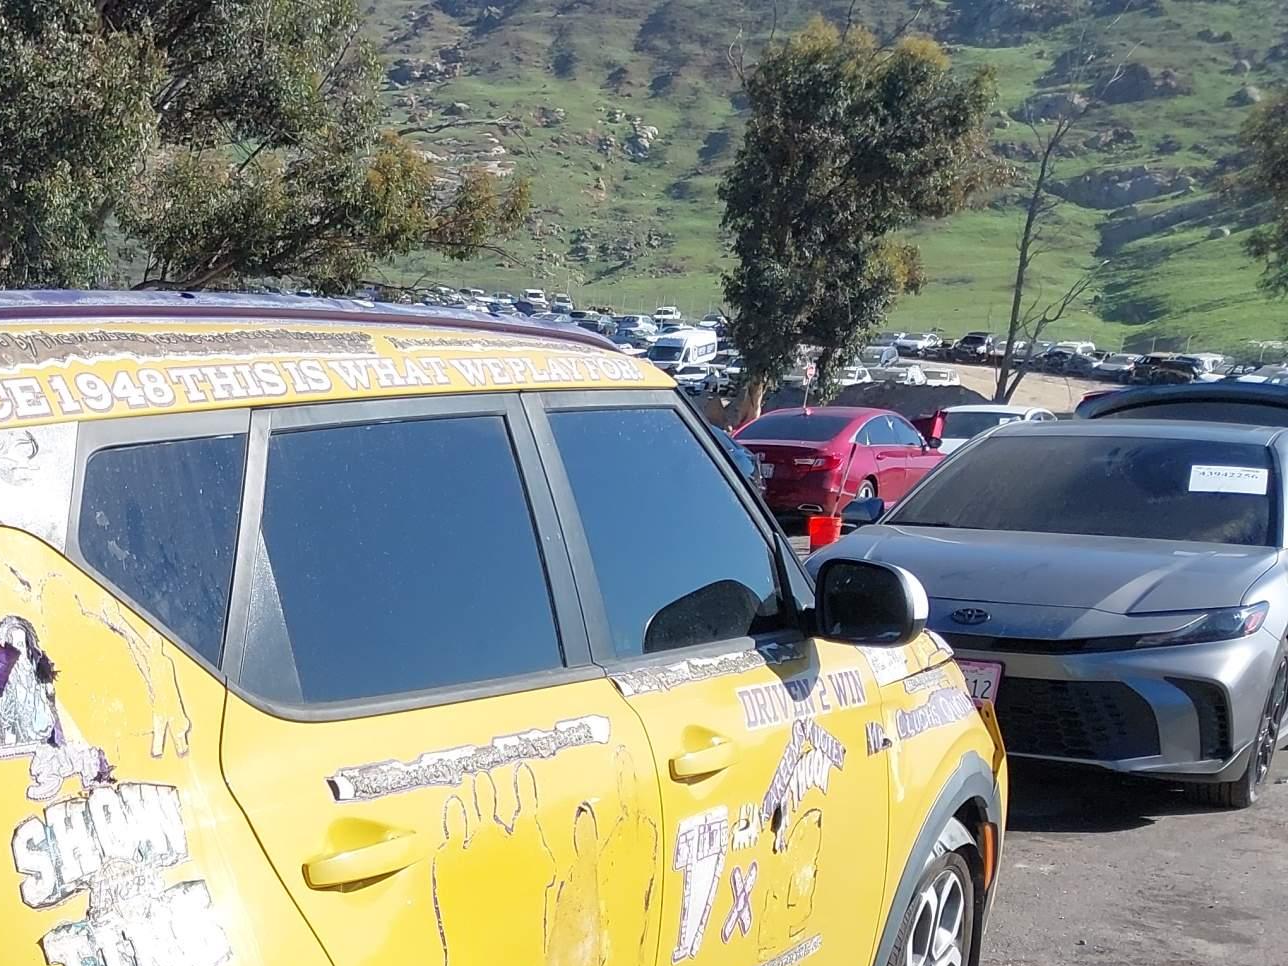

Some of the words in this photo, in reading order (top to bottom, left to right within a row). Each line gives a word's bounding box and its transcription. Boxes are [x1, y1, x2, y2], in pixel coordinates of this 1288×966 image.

[50, 368, 176, 413] 1948
[166, 358, 287, 402] THIS
[282, 358, 334, 395] IS
[329, 355, 452, 391] WHAT
[449, 357, 508, 387] WE
[510, 356, 585, 384] PLAY
[738, 679, 816, 728] DRIVEN
[817, 677, 831, 711] 2
[828, 669, 867, 708] WIN
